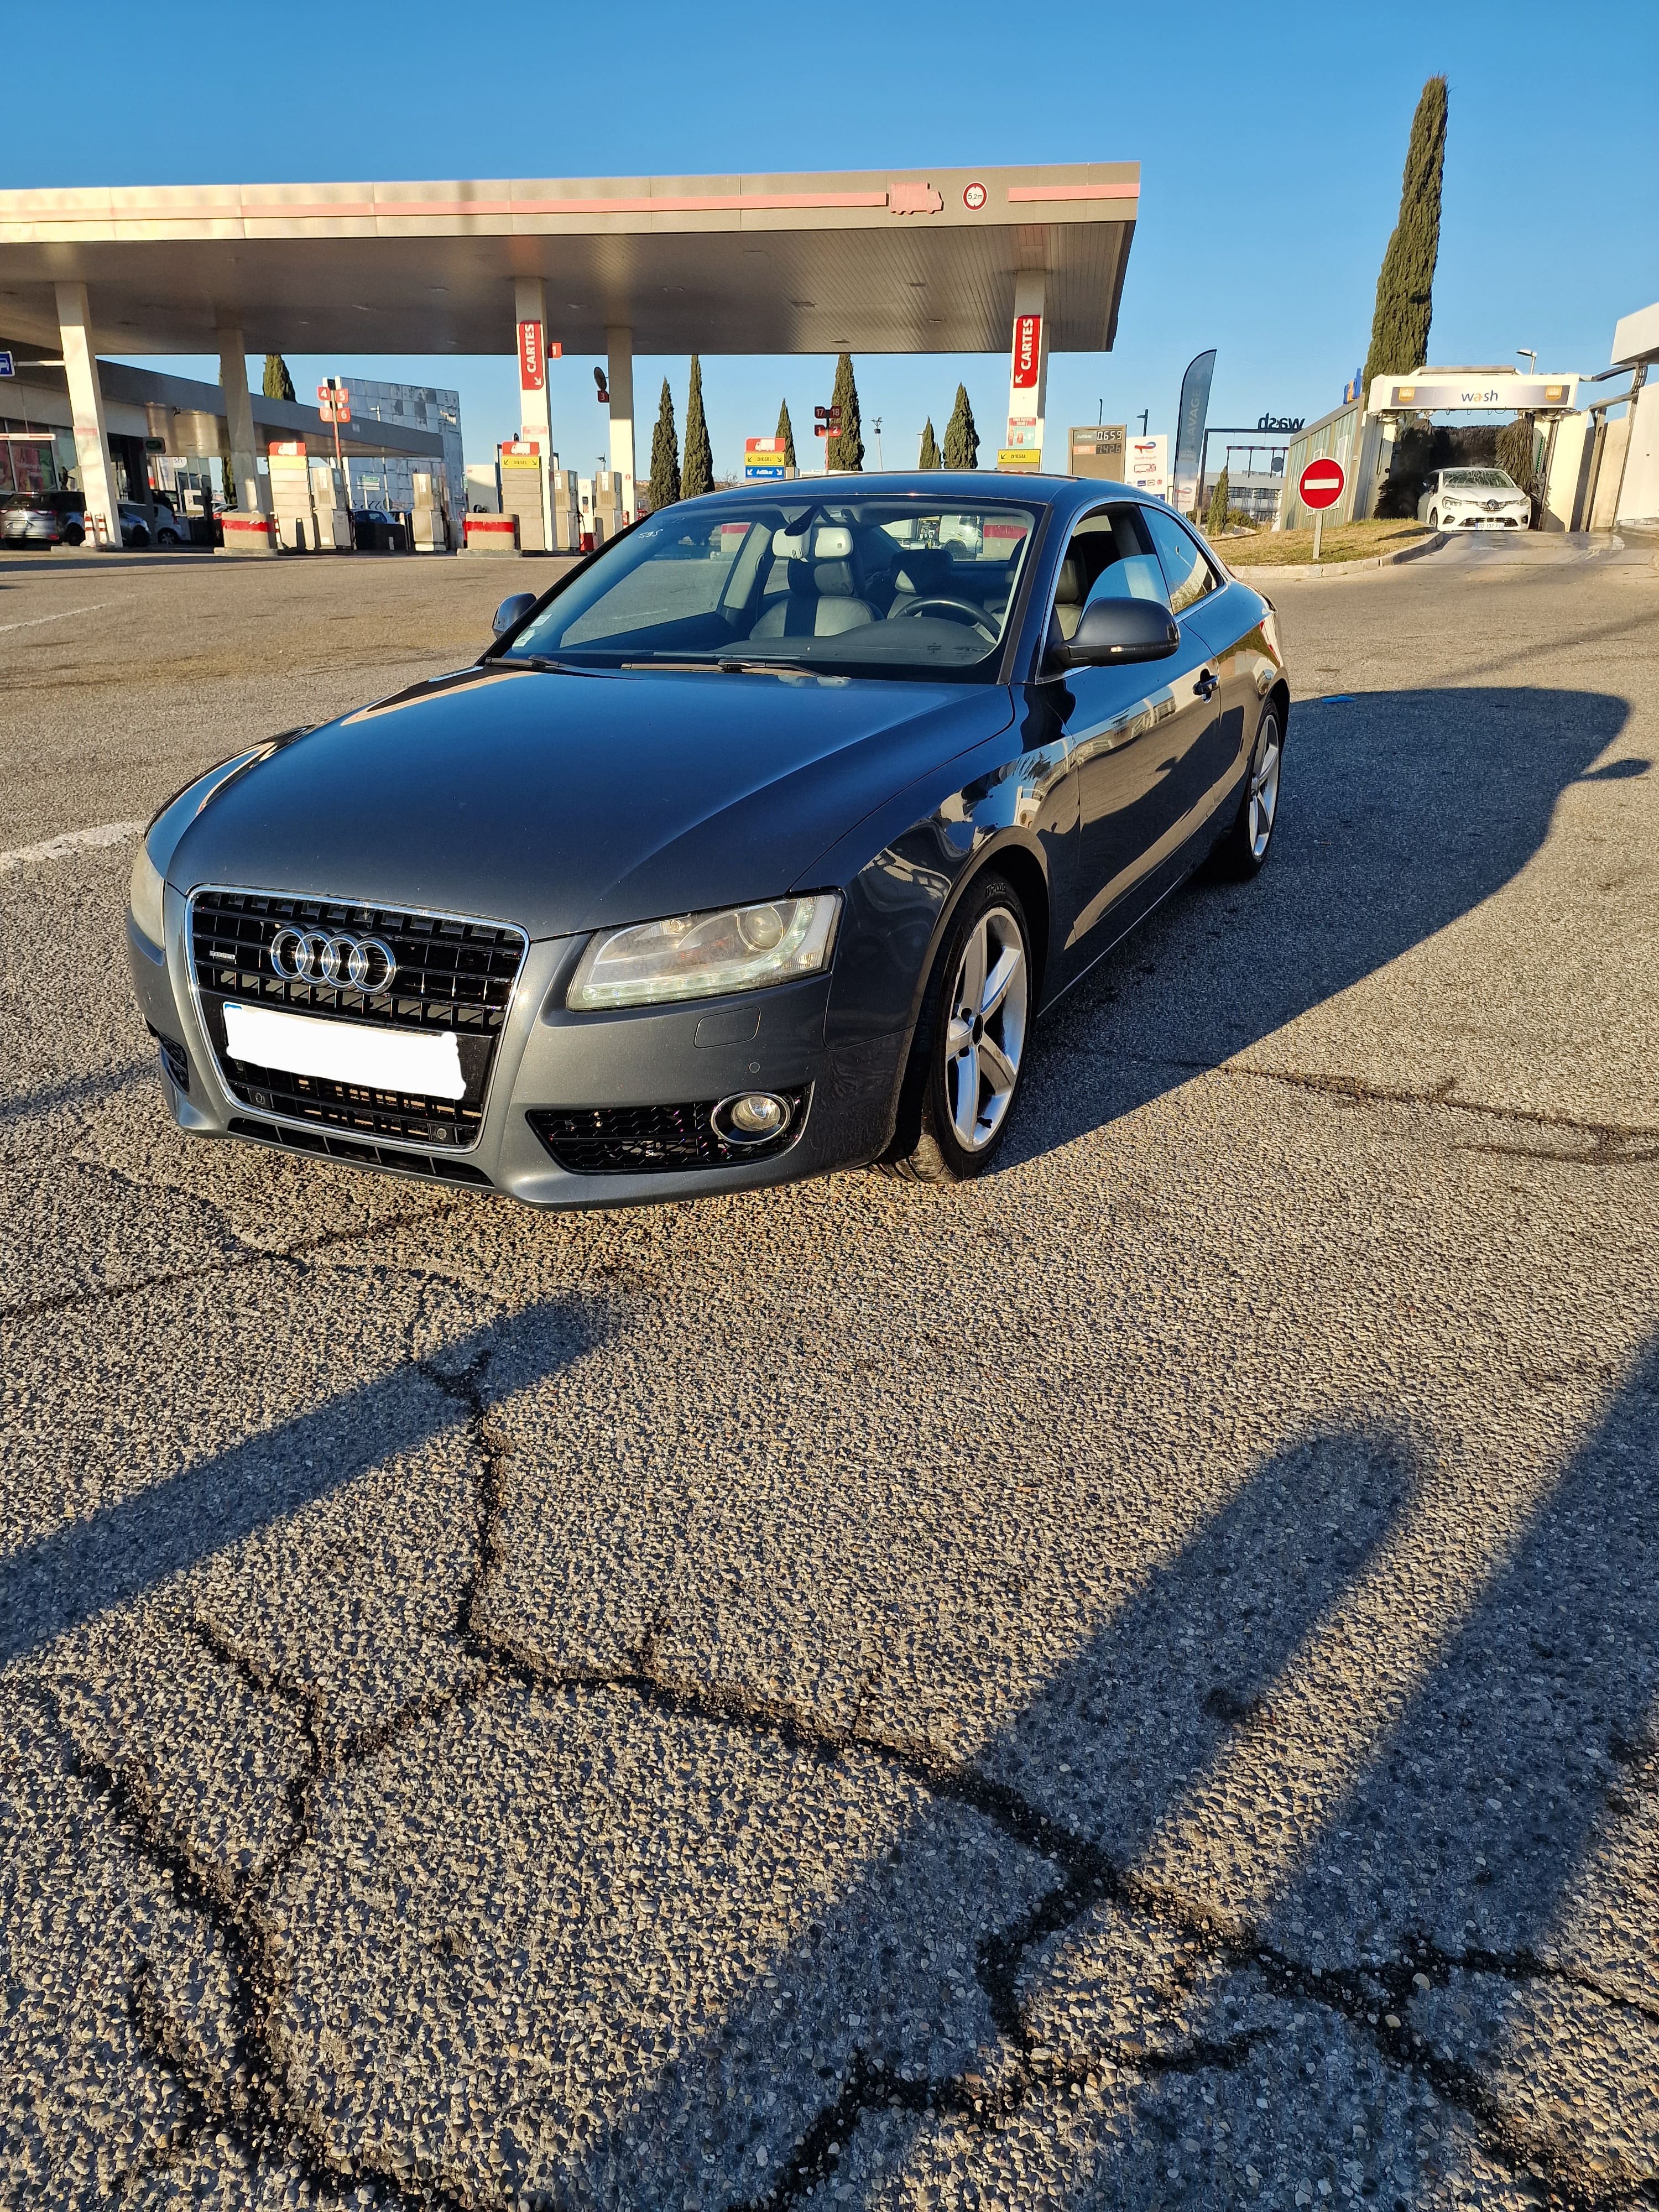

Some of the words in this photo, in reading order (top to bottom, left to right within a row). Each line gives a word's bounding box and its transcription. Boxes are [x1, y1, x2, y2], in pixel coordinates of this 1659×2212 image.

[524, 323, 537, 373] CARTES
[1020, 318, 1034, 371] CARTES
[320, 388, 328, 398] 4
[338, 390, 346, 401] 5
[601, 392, 606, 401] 3
[1462, 389, 1498, 402] wash
[324, 410, 330, 419] 7
[341, 410, 347, 420] 6
[1187, 388, 1201, 442] LAVAGE
